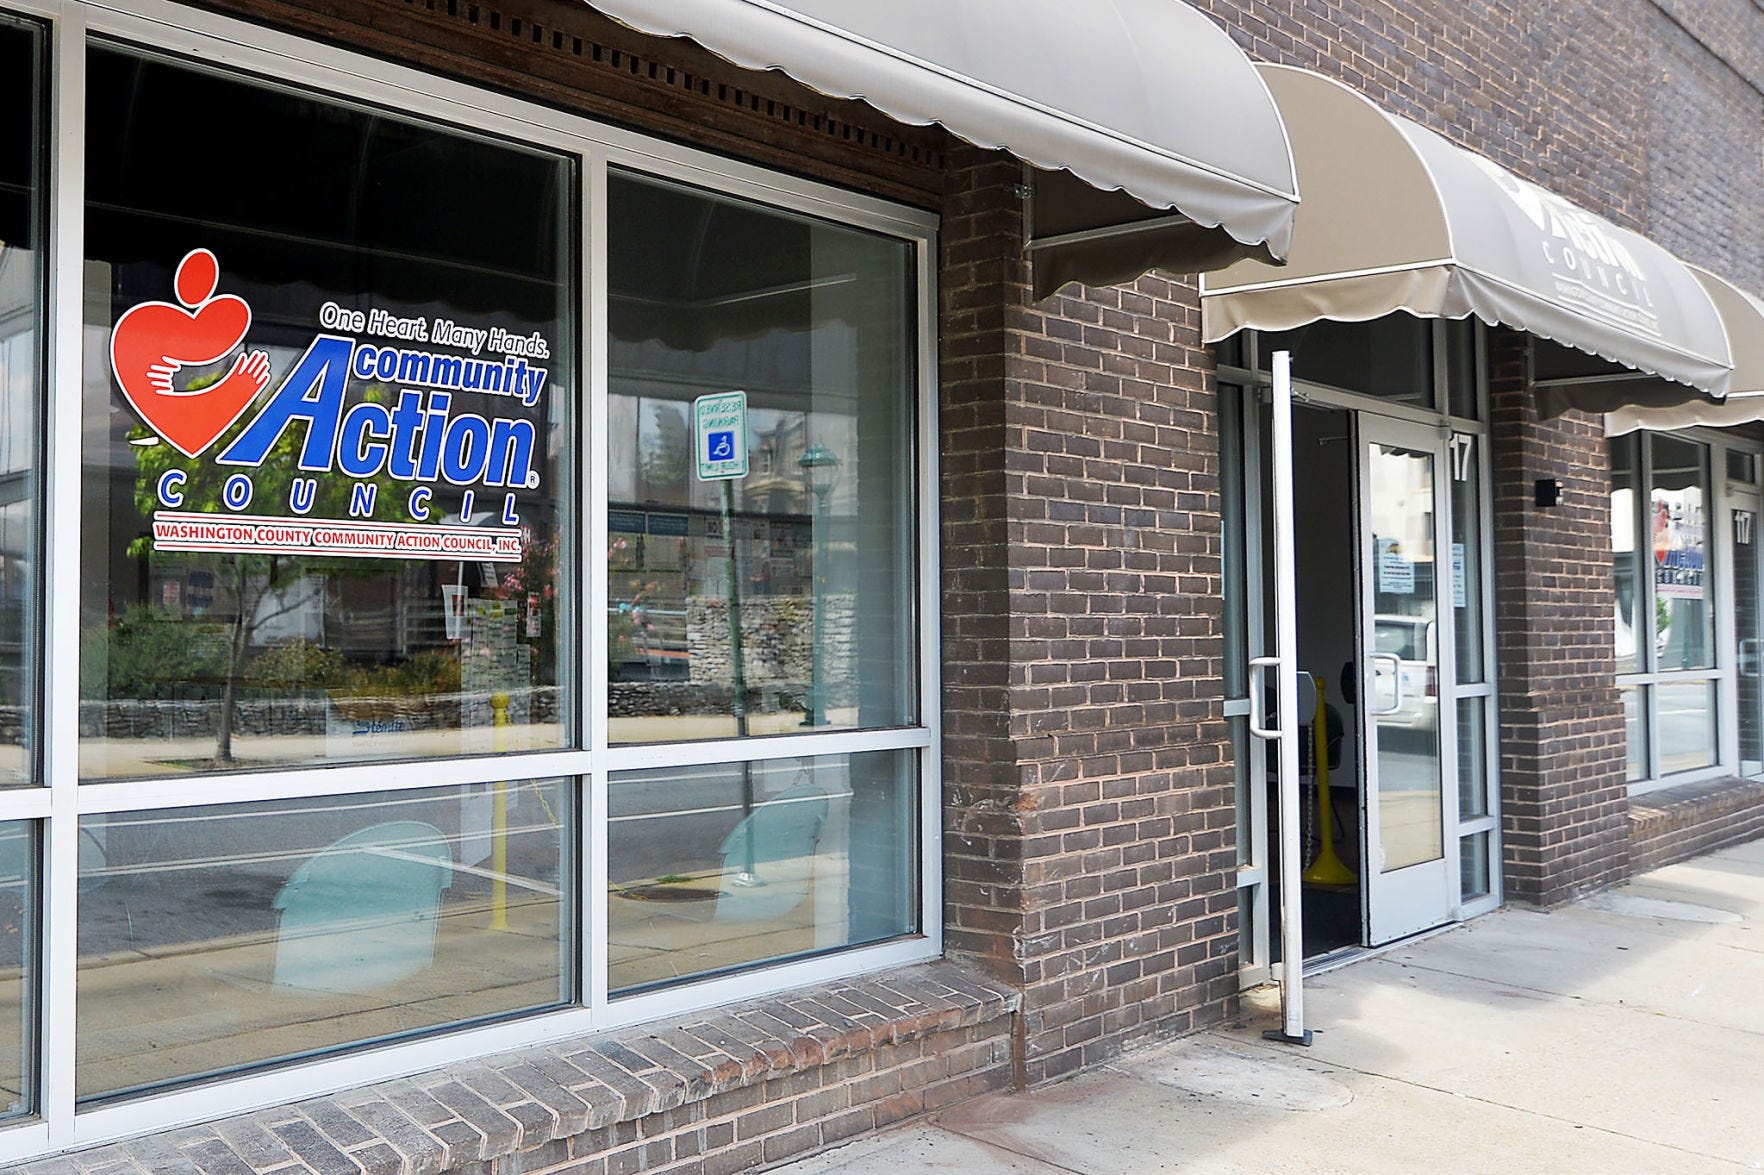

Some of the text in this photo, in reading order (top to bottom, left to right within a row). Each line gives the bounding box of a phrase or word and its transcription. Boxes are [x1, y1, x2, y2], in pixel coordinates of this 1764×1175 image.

[320, 303, 549, 358] One Heart. Many Hands.
[354, 345, 546, 405] community
[218, 336, 535, 487] Action
[157, 469, 520, 524] COUNCIL
[155, 524, 520, 551] WASHINGTON COUNTY COMMUNITY ACTION COUNCIL, INC.
